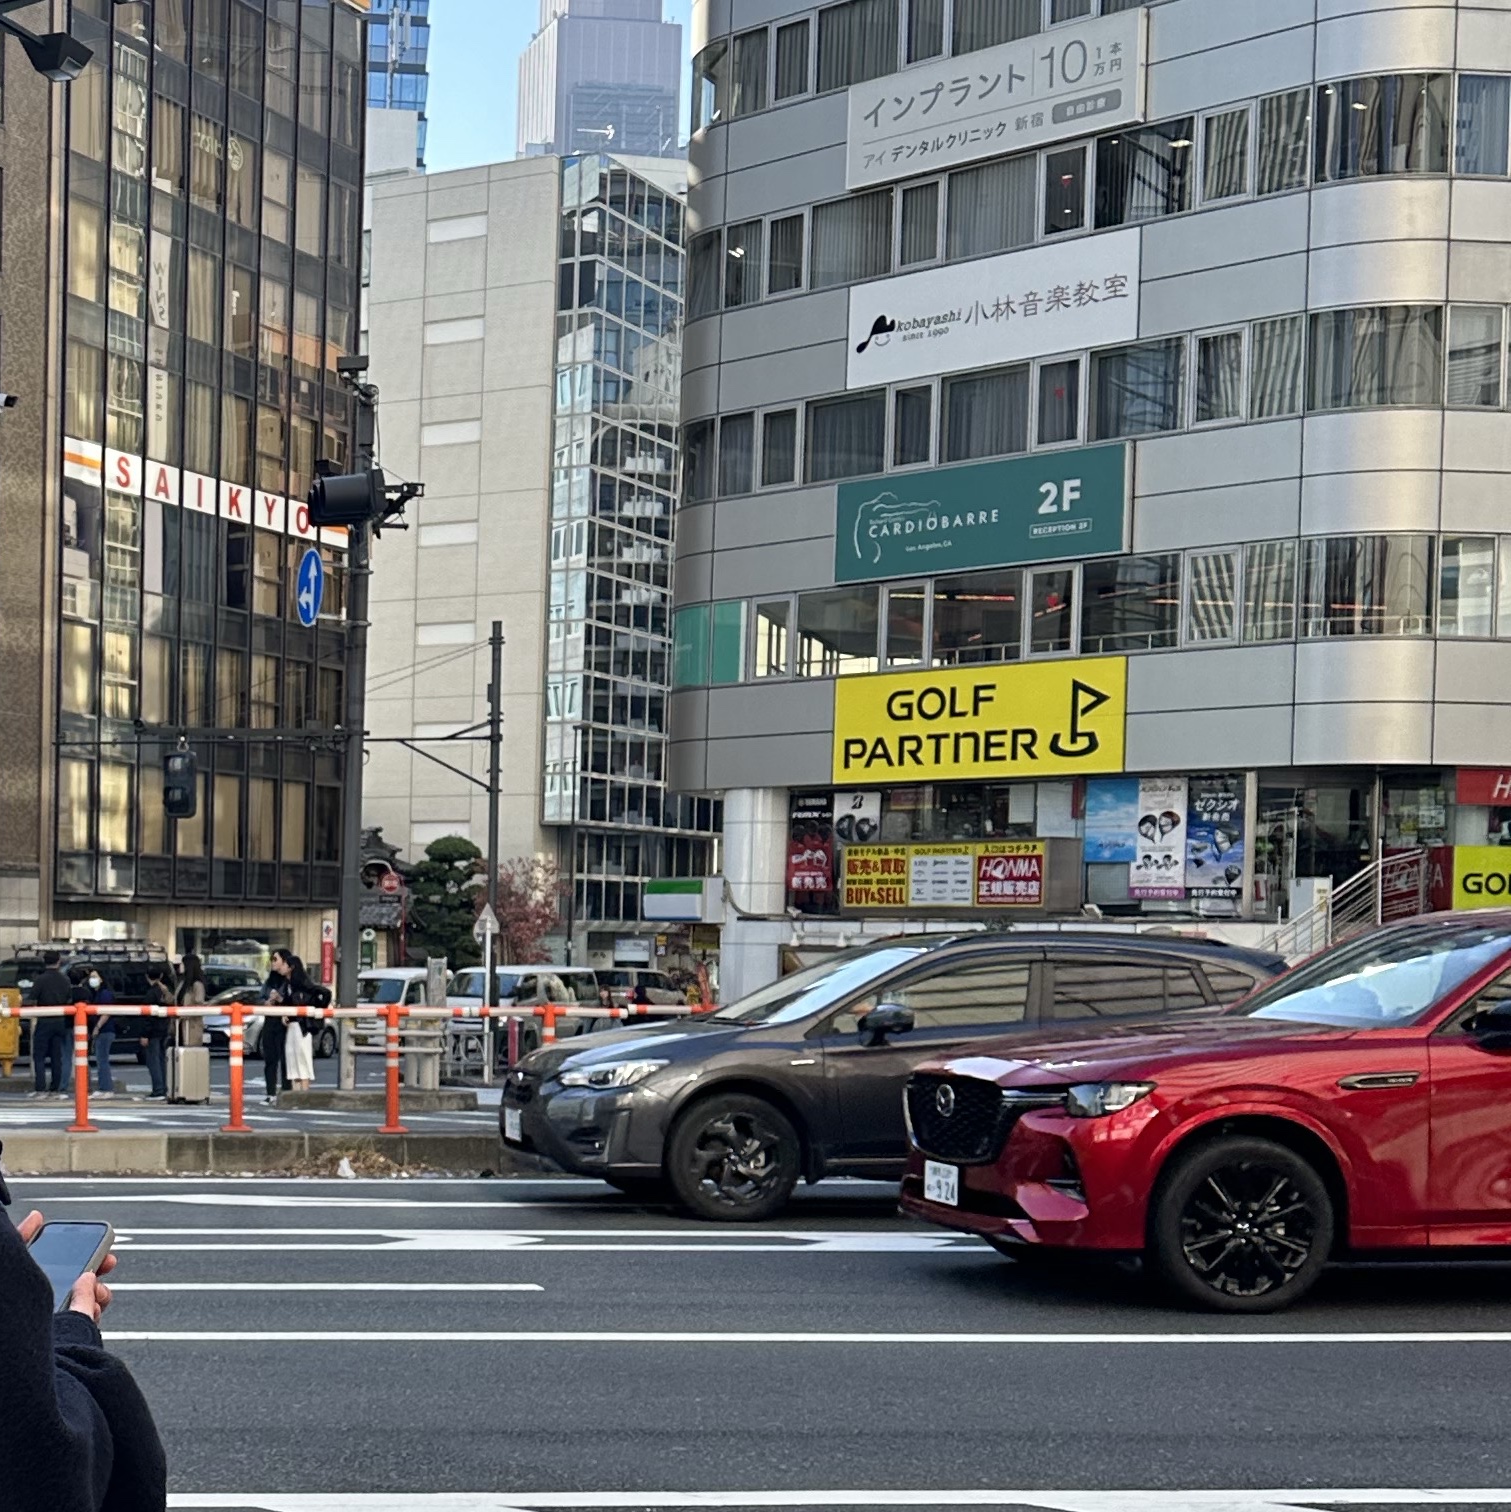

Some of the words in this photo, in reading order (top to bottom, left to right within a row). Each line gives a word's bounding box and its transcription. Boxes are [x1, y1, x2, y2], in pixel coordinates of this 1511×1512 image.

[1040, 39, 1087, 89] 10
[1093, 57, 1123, 77] 万円
[863, 64, 1025, 128] インプラント
[892, 121, 1007, 163] デンタルクリニック
[1014, 112, 1044, 132] 新宿
[964, 273, 1129, 326] 小林音楽教室
[896, 308, 962, 333] kobayashi
[115, 455, 310, 534] SAIKYO
[1037, 478, 1082, 516] 2F
[868, 508, 1000, 539] CARDIOBARRE
[1032, 522, 1077, 536] RECEPTION
[886, 684, 997, 721] GOLF
[843, 728, 1038, 769] PARTNER
[1492, 773, 1511, 799] H
[1194, 799, 1238, 812] ゼクシオ
[979, 856, 1041, 879] HONMA
[845, 886, 906, 904] BUY&SELL
[1462, 872, 1511, 895] GO
